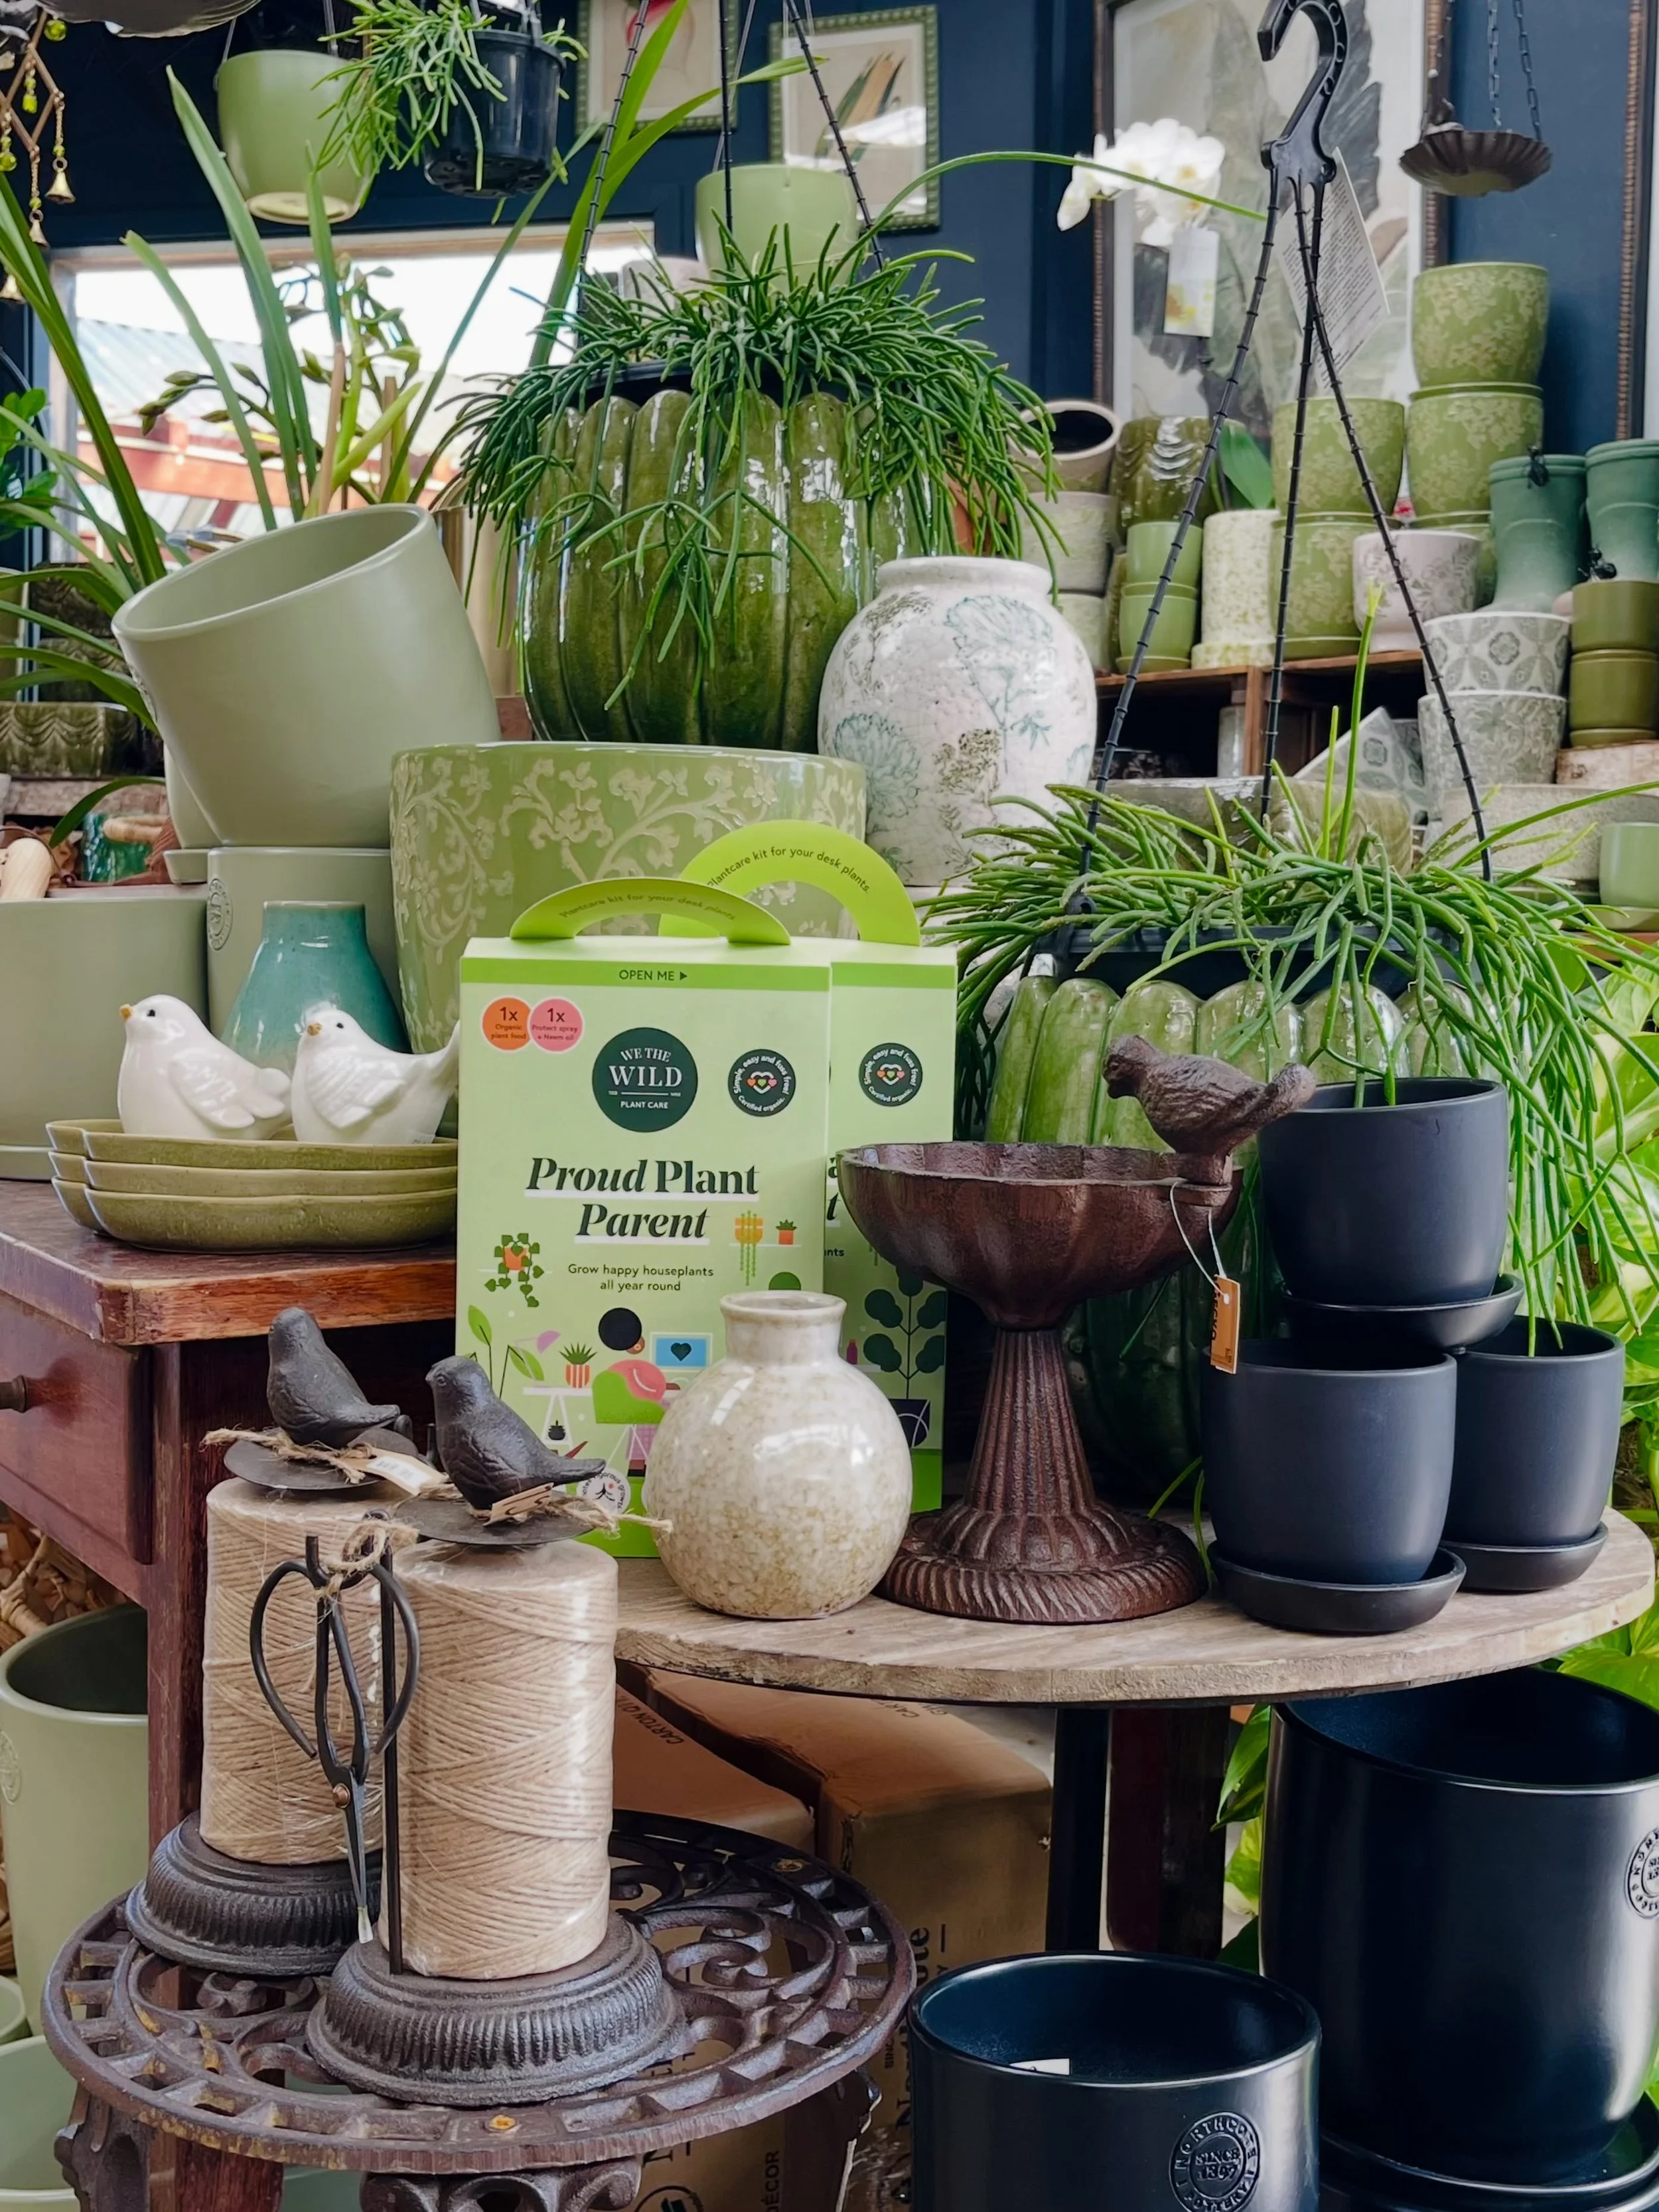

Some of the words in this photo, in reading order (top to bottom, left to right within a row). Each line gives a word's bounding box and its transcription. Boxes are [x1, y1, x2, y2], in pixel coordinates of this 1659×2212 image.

[753, 849, 768, 861] kit
[771, 846, 786, 857] for
[790, 848, 814, 858] your
[817, 851, 841, 869] desk
[559, 898, 606, 919] Plantcare
[607, 895, 623, 903] kit
[678, 897, 703, 908] desk
[618, 969, 653, 981] OPEN
[657, 970, 675, 981] ME
[499, 1006, 518, 1021] 1x
[547, 1007, 565, 1023] 1x
[495, 1023, 523, 1032] Organic
[620, 1047, 642, 1062] WE
[644, 1047, 672, 1063] THE
[873, 1049, 889, 1060] easy
[743, 1056, 759, 1067] easy
[775, 1060, 788, 1075] fuss
[609, 1065, 682, 1087] WILD
[526, 1157, 648, 1192] Proud
[655, 1160, 759, 1195] Plant
[576, 1203, 710, 1238] Parent
[568, 1264, 599, 1274] Grow
[603, 1264, 639, 1279] happy
[643, 1265, 714, 1279] houseplants
[600, 1280, 614, 1290] all
[618, 1282, 644, 1293] year
[648, 1281, 681, 1291] round
